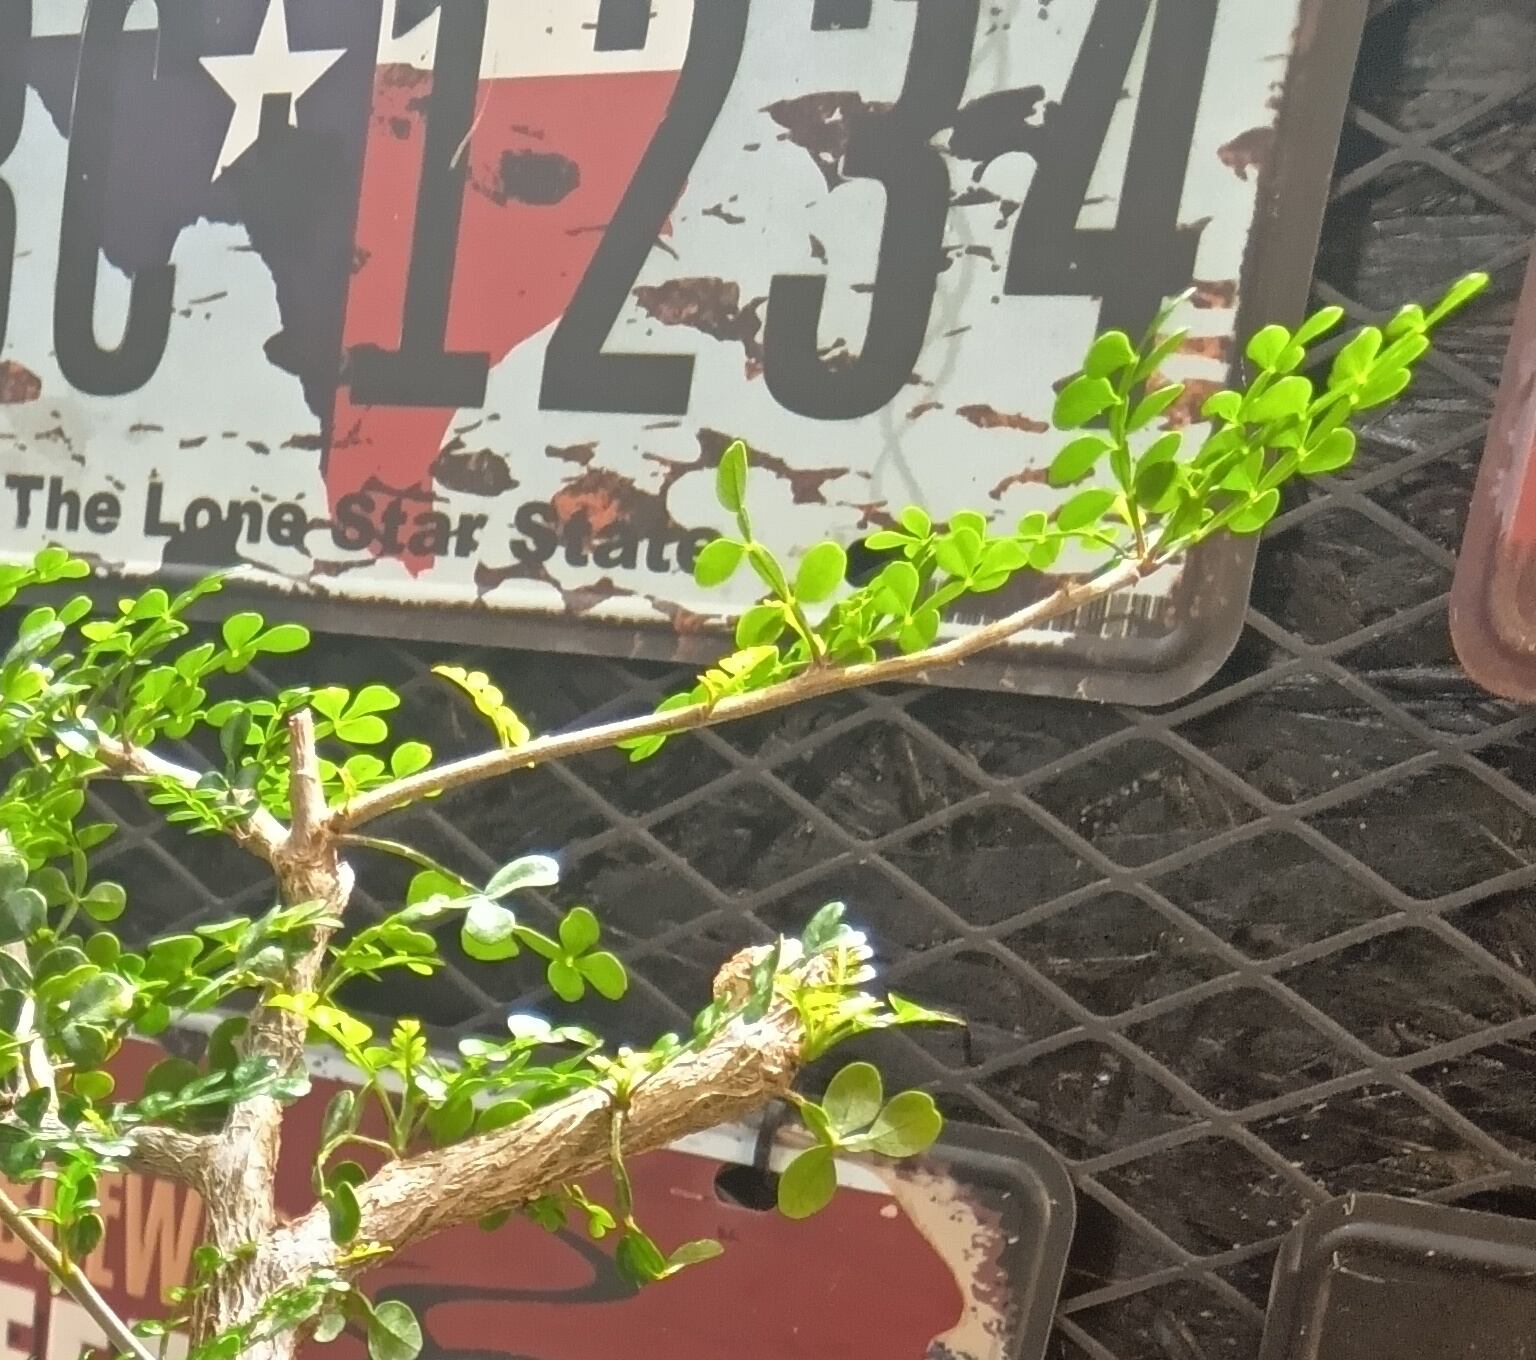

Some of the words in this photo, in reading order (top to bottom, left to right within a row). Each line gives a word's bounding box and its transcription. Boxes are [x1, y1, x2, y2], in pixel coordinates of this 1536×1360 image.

[5, 474, 122, 534] The
[143, 480, 309, 548] Lone
[330, 492, 489, 557] Star
